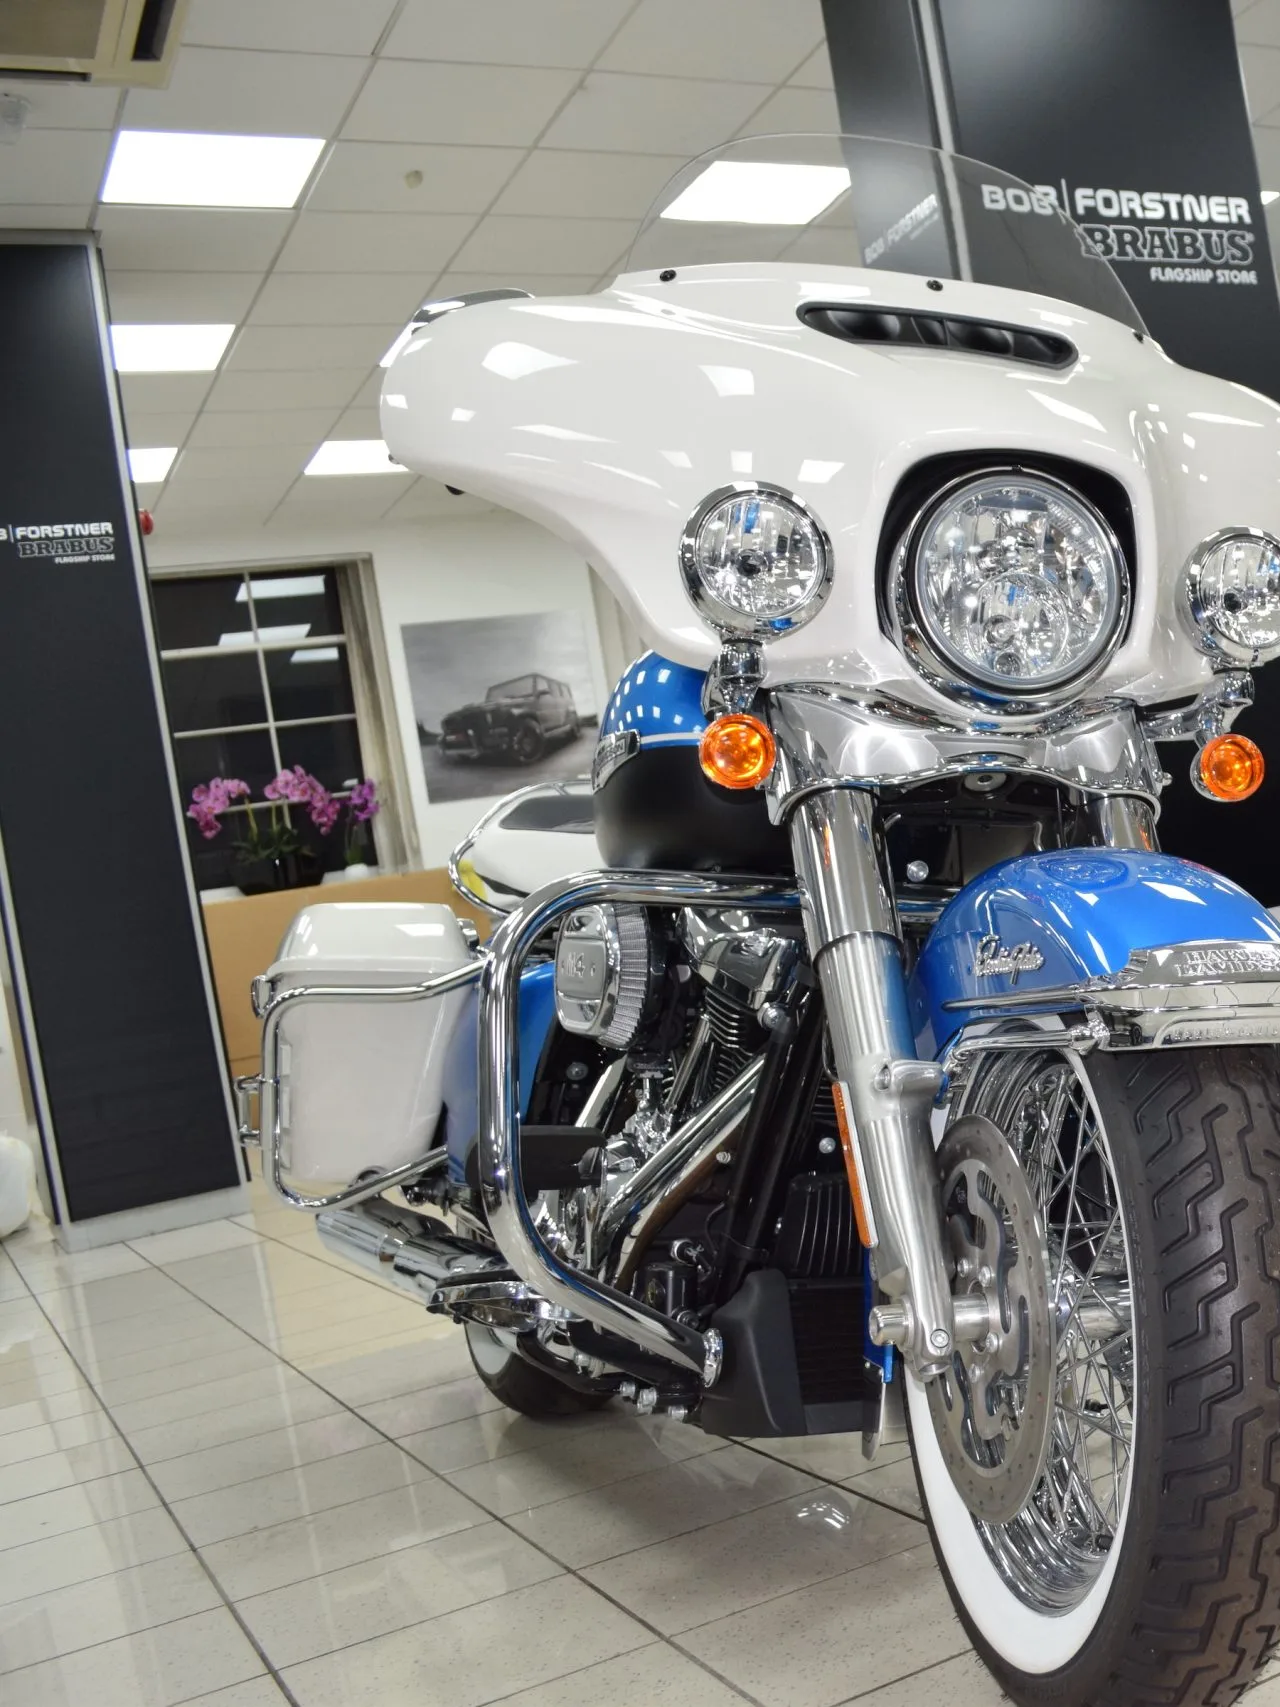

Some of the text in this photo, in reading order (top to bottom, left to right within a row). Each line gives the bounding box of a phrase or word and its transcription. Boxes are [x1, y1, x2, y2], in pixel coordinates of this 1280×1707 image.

[981, 184, 1252, 225] BOB FORSTNER
[1076, 223, 1255, 265] BRABUS
[1150, 266, 1257, 285] FLAGSHIP STORE
[15, 522, 114, 540] FORSTNER
[18, 537, 115, 558] BRABUS
